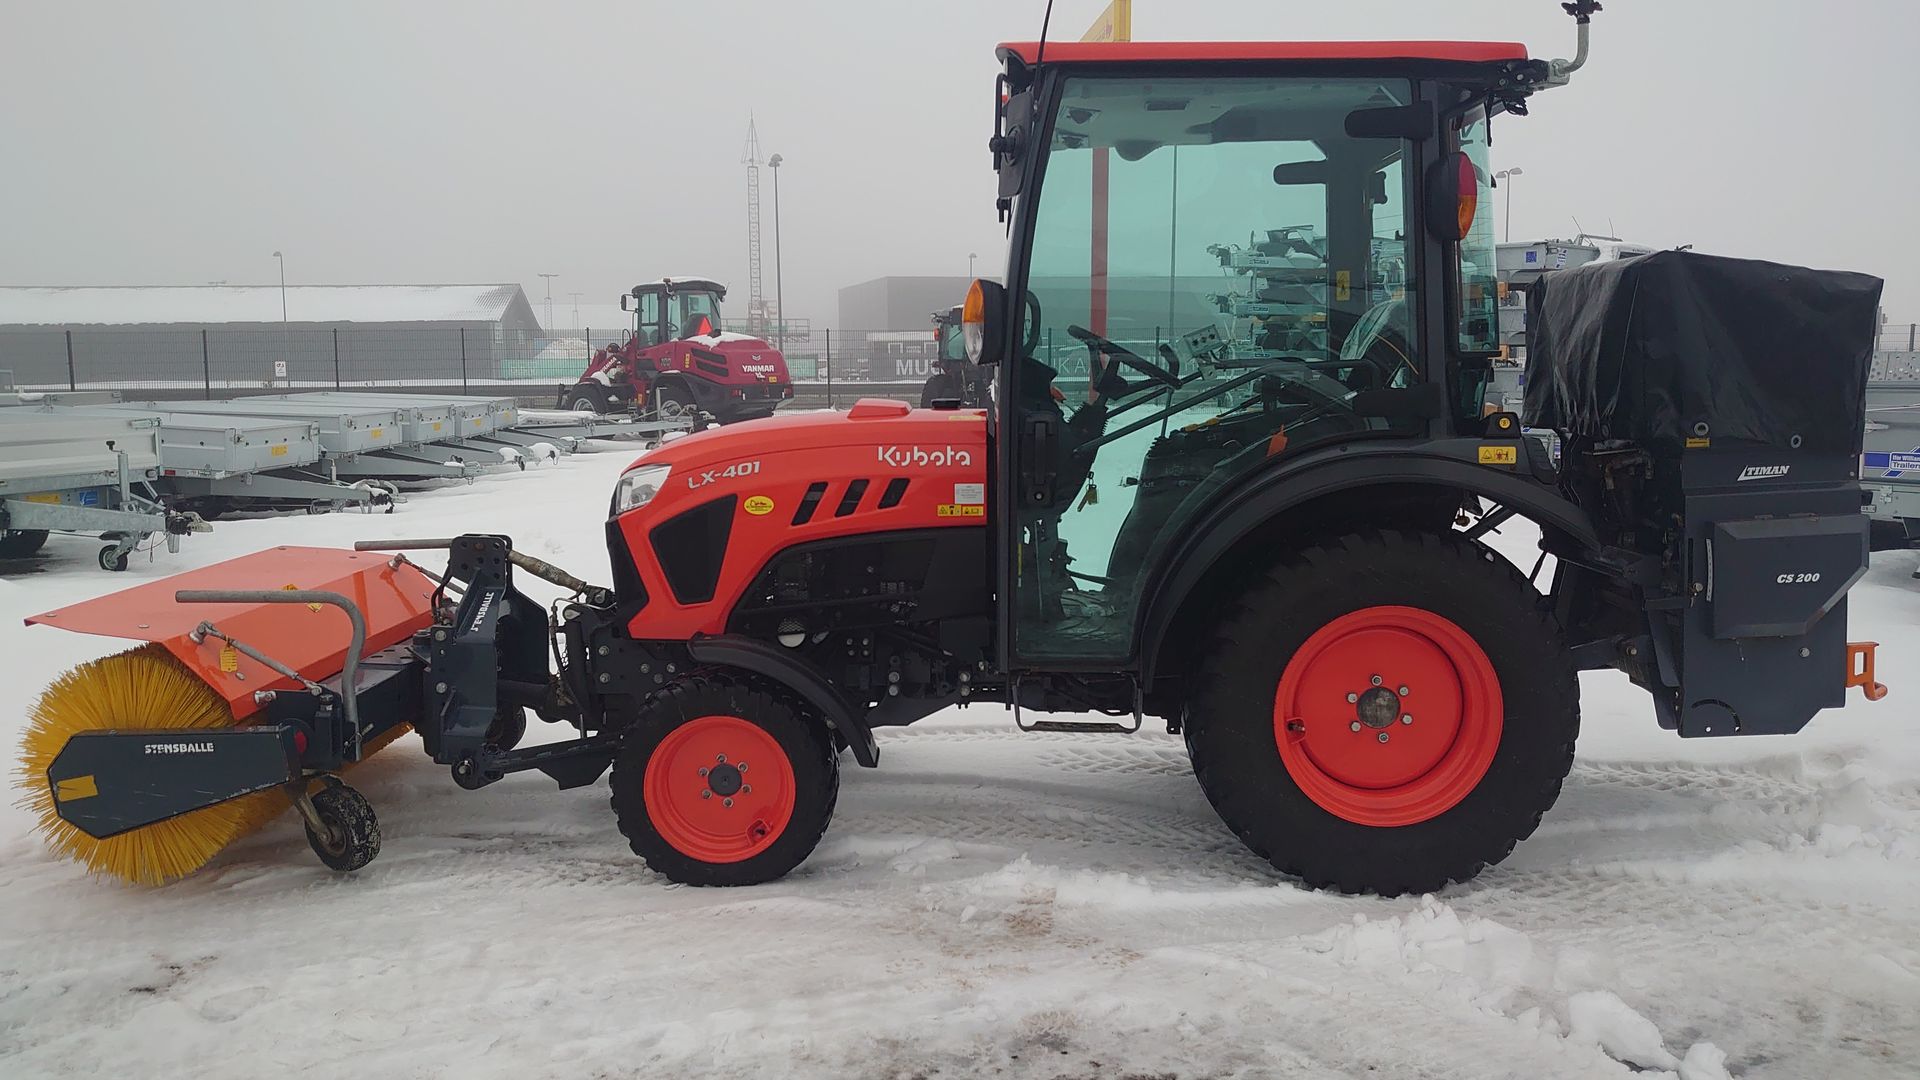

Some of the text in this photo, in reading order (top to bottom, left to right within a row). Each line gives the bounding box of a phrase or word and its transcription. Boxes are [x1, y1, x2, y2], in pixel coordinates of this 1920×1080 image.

[742, 364, 775, 373] YANMAR
[878, 445, 971, 467] Kubota
[688, 461, 761, 489] LX-401
[1746, 465, 1790, 476] TIMAN
[1776, 572, 1820, 584] CS 200
[144, 742, 215, 754] STENSBALLE
